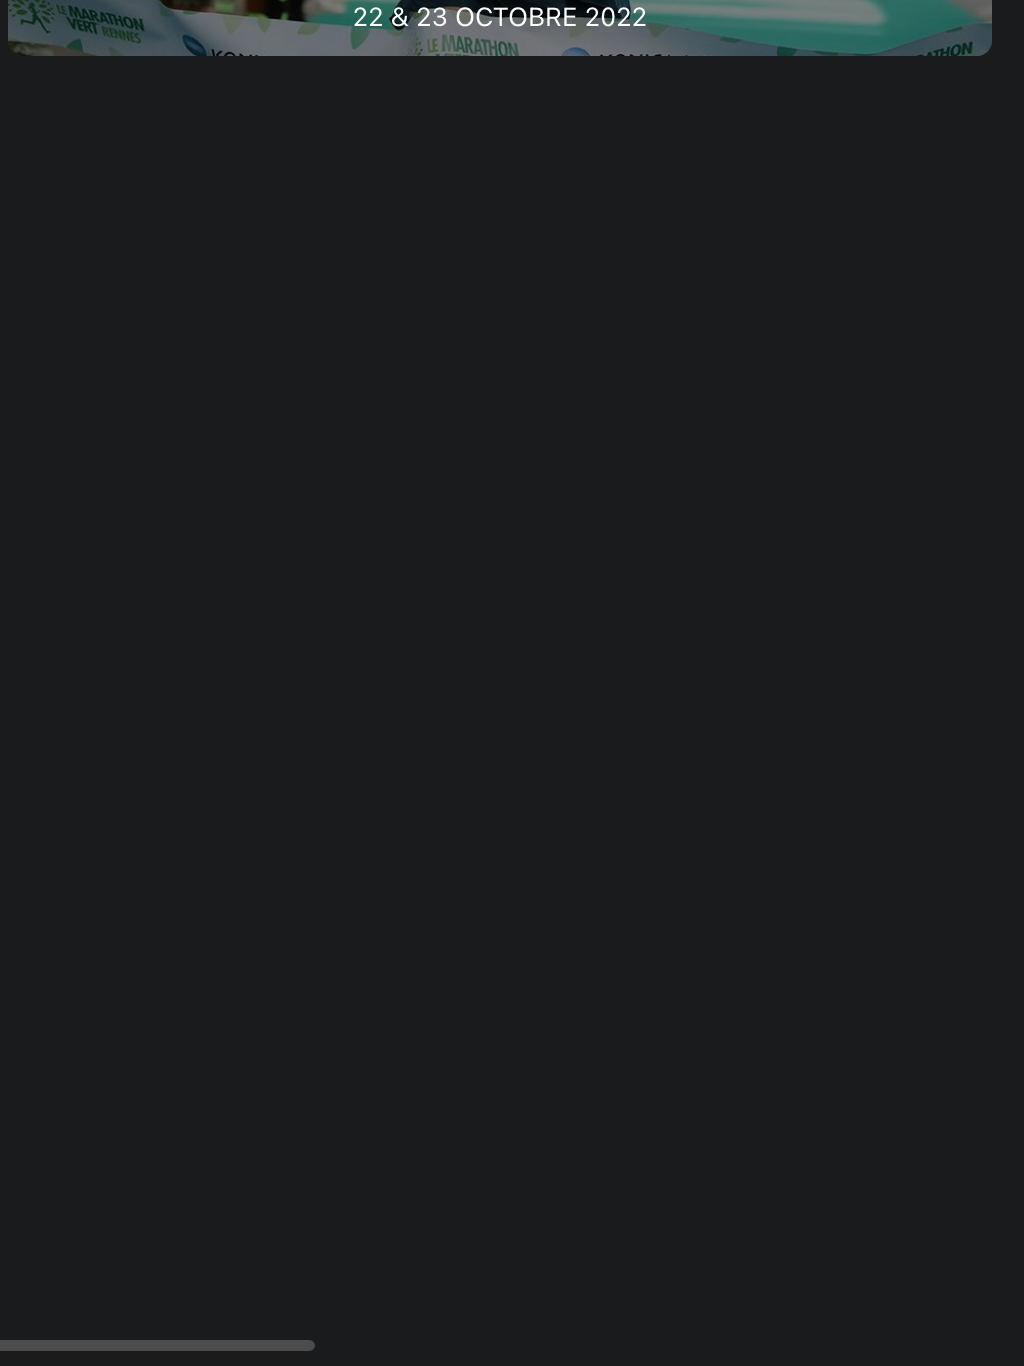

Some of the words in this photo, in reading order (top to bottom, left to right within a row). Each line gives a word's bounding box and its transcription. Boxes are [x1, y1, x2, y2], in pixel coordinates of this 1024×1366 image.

[66, 17, 97, 34] VERT
[101, 26, 141, 44] RENNES
[68, 5, 145, 32] MARATHON
[427, 38, 438, 52] LE
[441, 34, 519, 56] MARATHON
